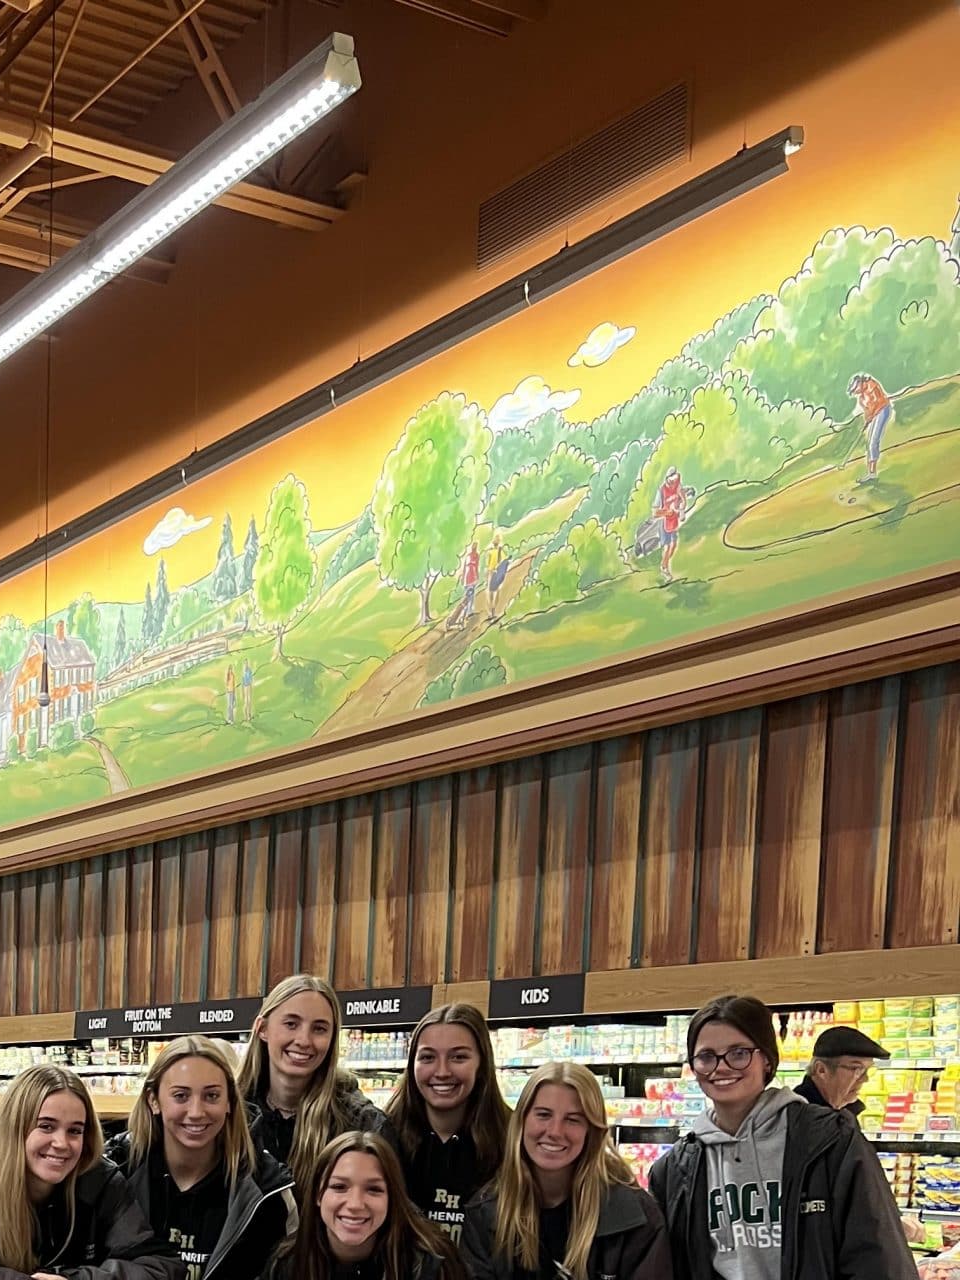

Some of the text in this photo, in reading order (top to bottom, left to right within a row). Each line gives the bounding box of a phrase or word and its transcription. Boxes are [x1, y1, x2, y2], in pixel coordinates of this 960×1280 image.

[521, 988, 550, 1005] KIDS
[346, 998, 400, 1016] DRINKABLE
[124, 1007, 172, 1022] FRUIT ON THE
[199, 1009, 234, 1023] BLENDED
[88, 1018, 108, 1029] LIGHT
[132, 1021, 162, 1033] BOTTOM
[428, 1210, 465, 1222] HENR
